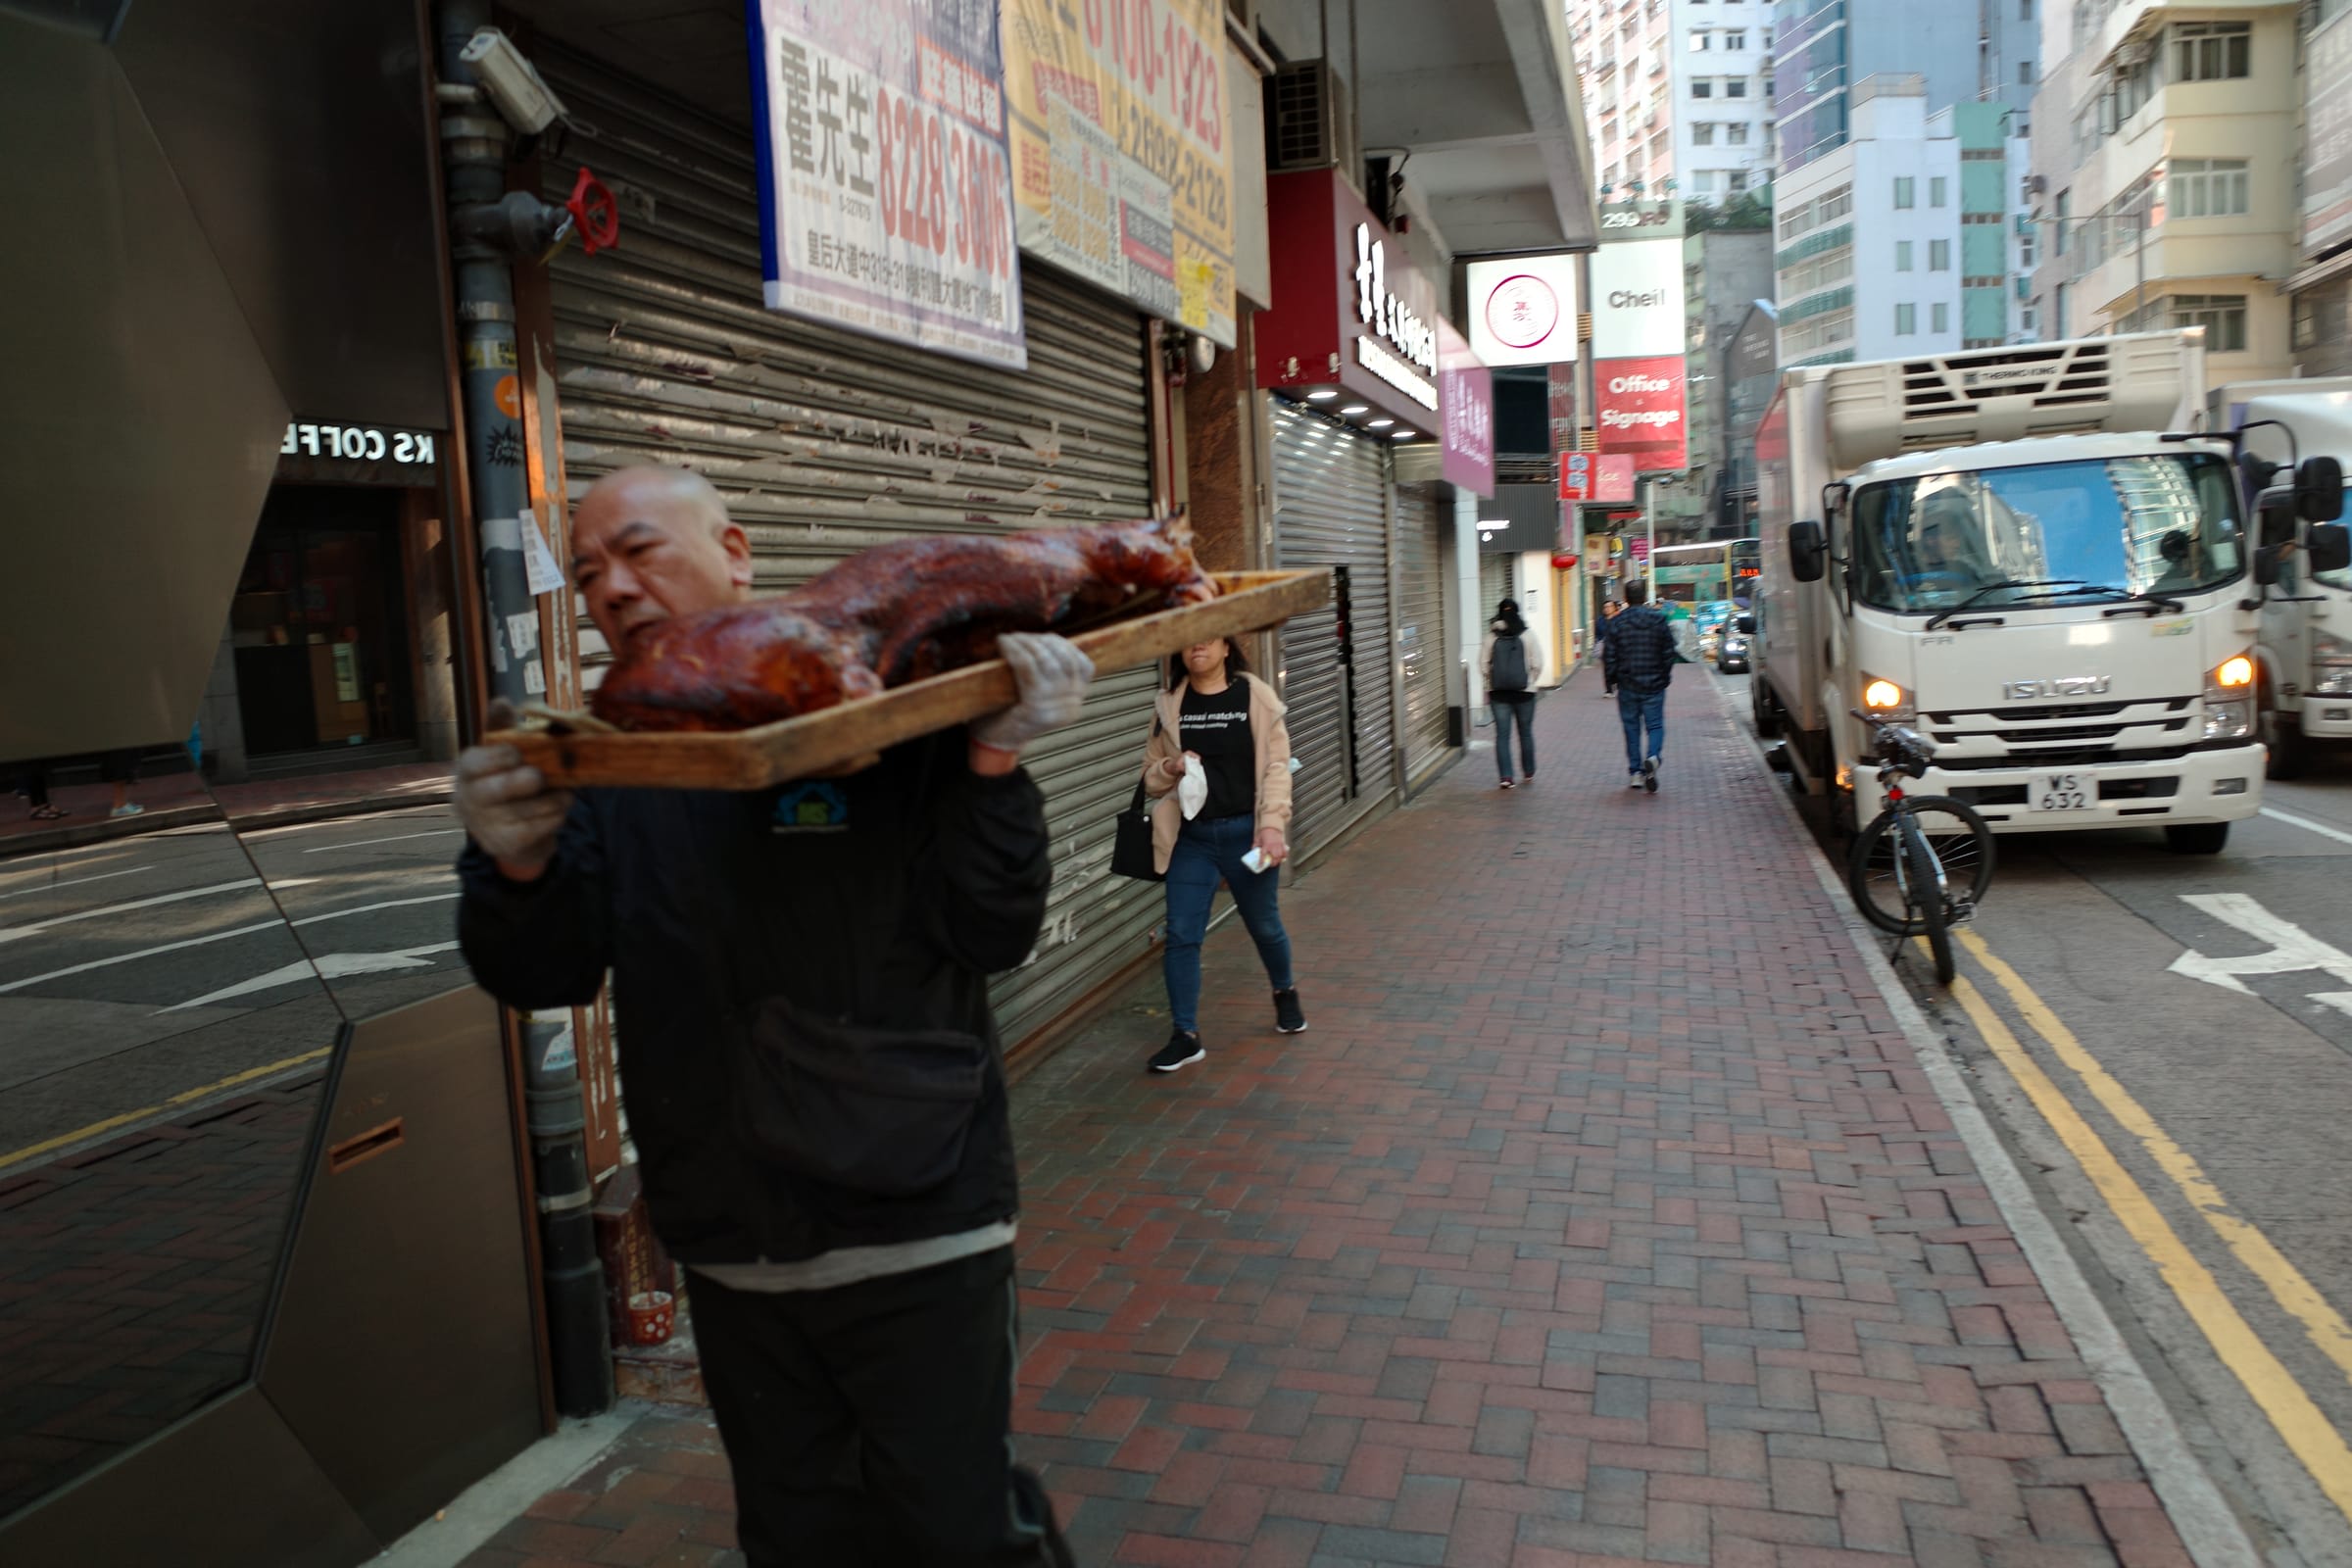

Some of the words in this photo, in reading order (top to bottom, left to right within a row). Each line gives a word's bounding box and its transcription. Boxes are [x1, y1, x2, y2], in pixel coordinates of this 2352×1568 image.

[781, 35, 874, 198] 霍先生
[877, 86, 947, 257] 8228
[950, 127, 1009, 281] 3606
[1608, 289, 1666, 309] Cheil
[1608, 375, 1671, 394] Office
[1599, 409, 1681, 429] Signage
[2003, 673, 2112, 700] ISUZU
[2041, 792, 2085, 809] 632
